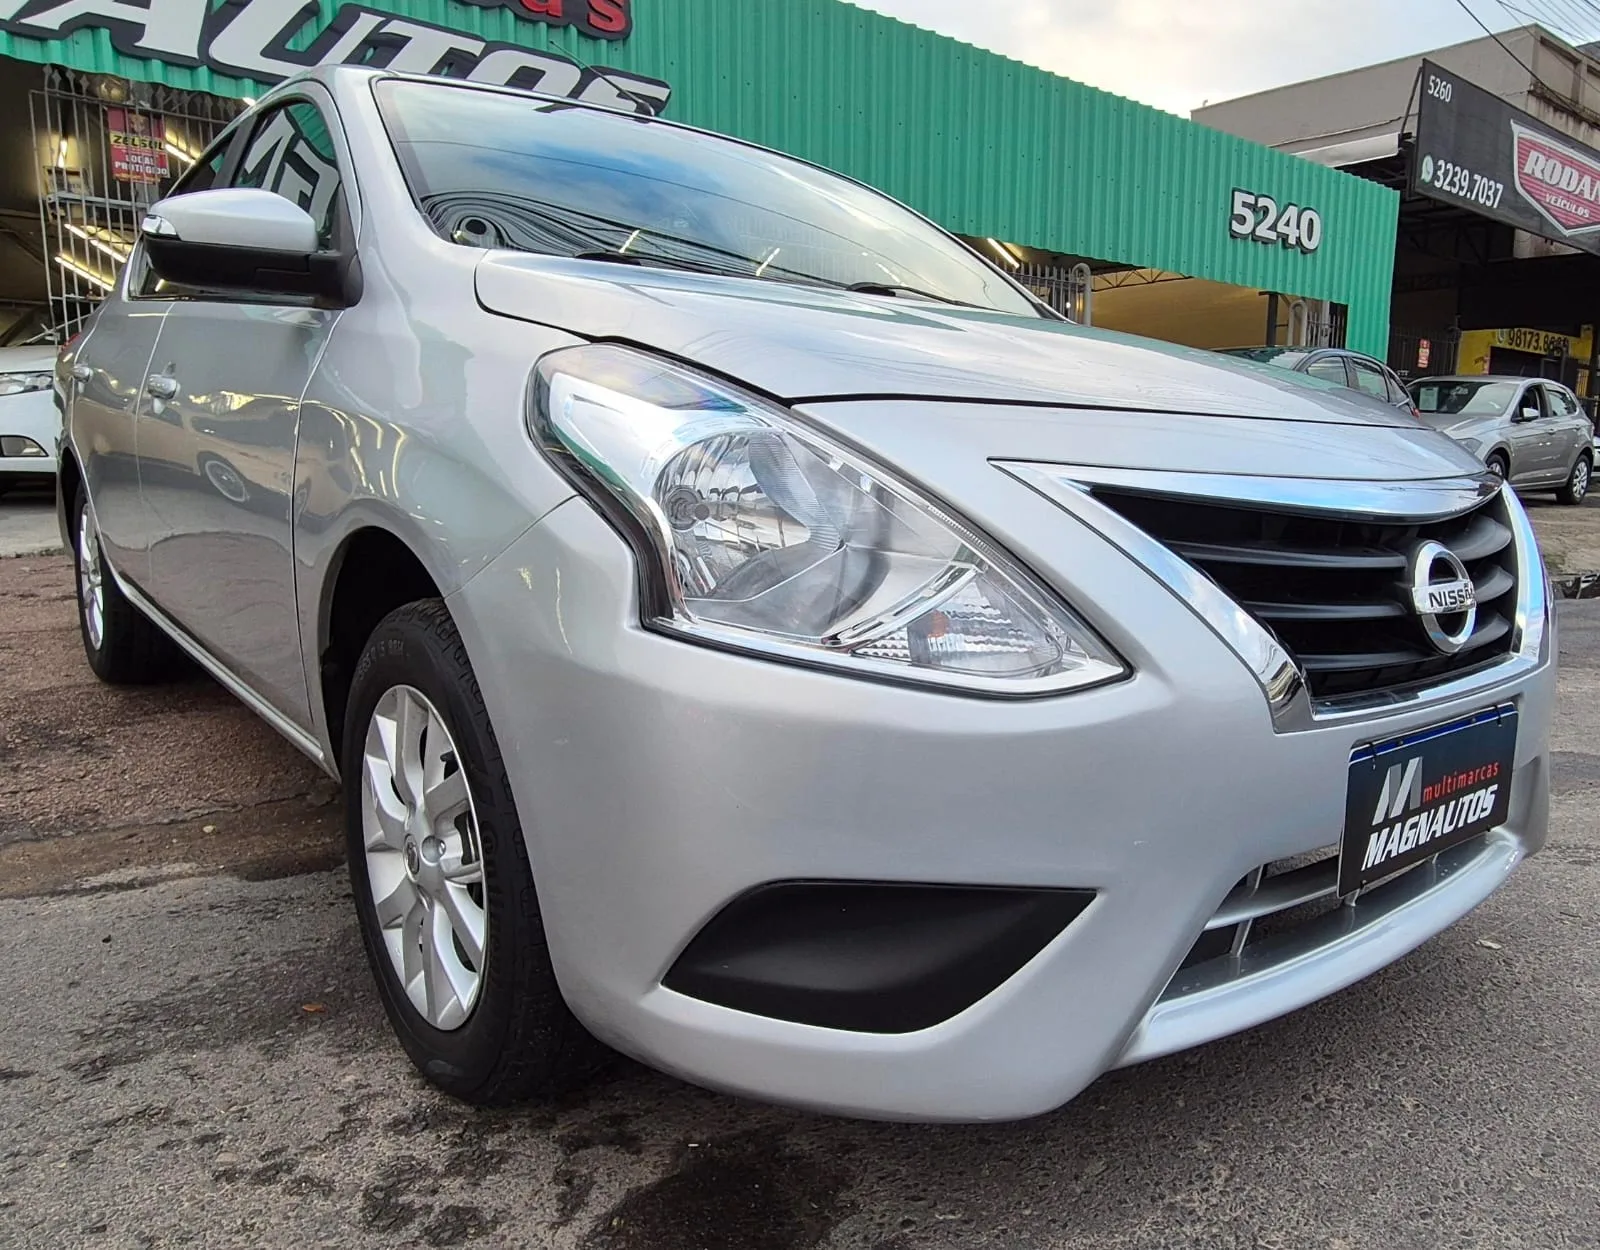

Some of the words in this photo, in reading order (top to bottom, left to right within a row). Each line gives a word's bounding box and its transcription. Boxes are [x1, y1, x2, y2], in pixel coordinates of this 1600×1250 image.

[0, 0, 671, 114] AUTO
[1427, 75, 1452, 102] 5260
[125, 154, 154, 165] LOCAL
[1434, 159, 1504, 209] 3239.7037
[1545, 192, 1591, 218] VEÍCULOS
[1230, 189, 1321, 251] 5240
[1422, 762, 1499, 803] multimarcas
[1360, 784, 1498, 871] MAGNAUTOS
